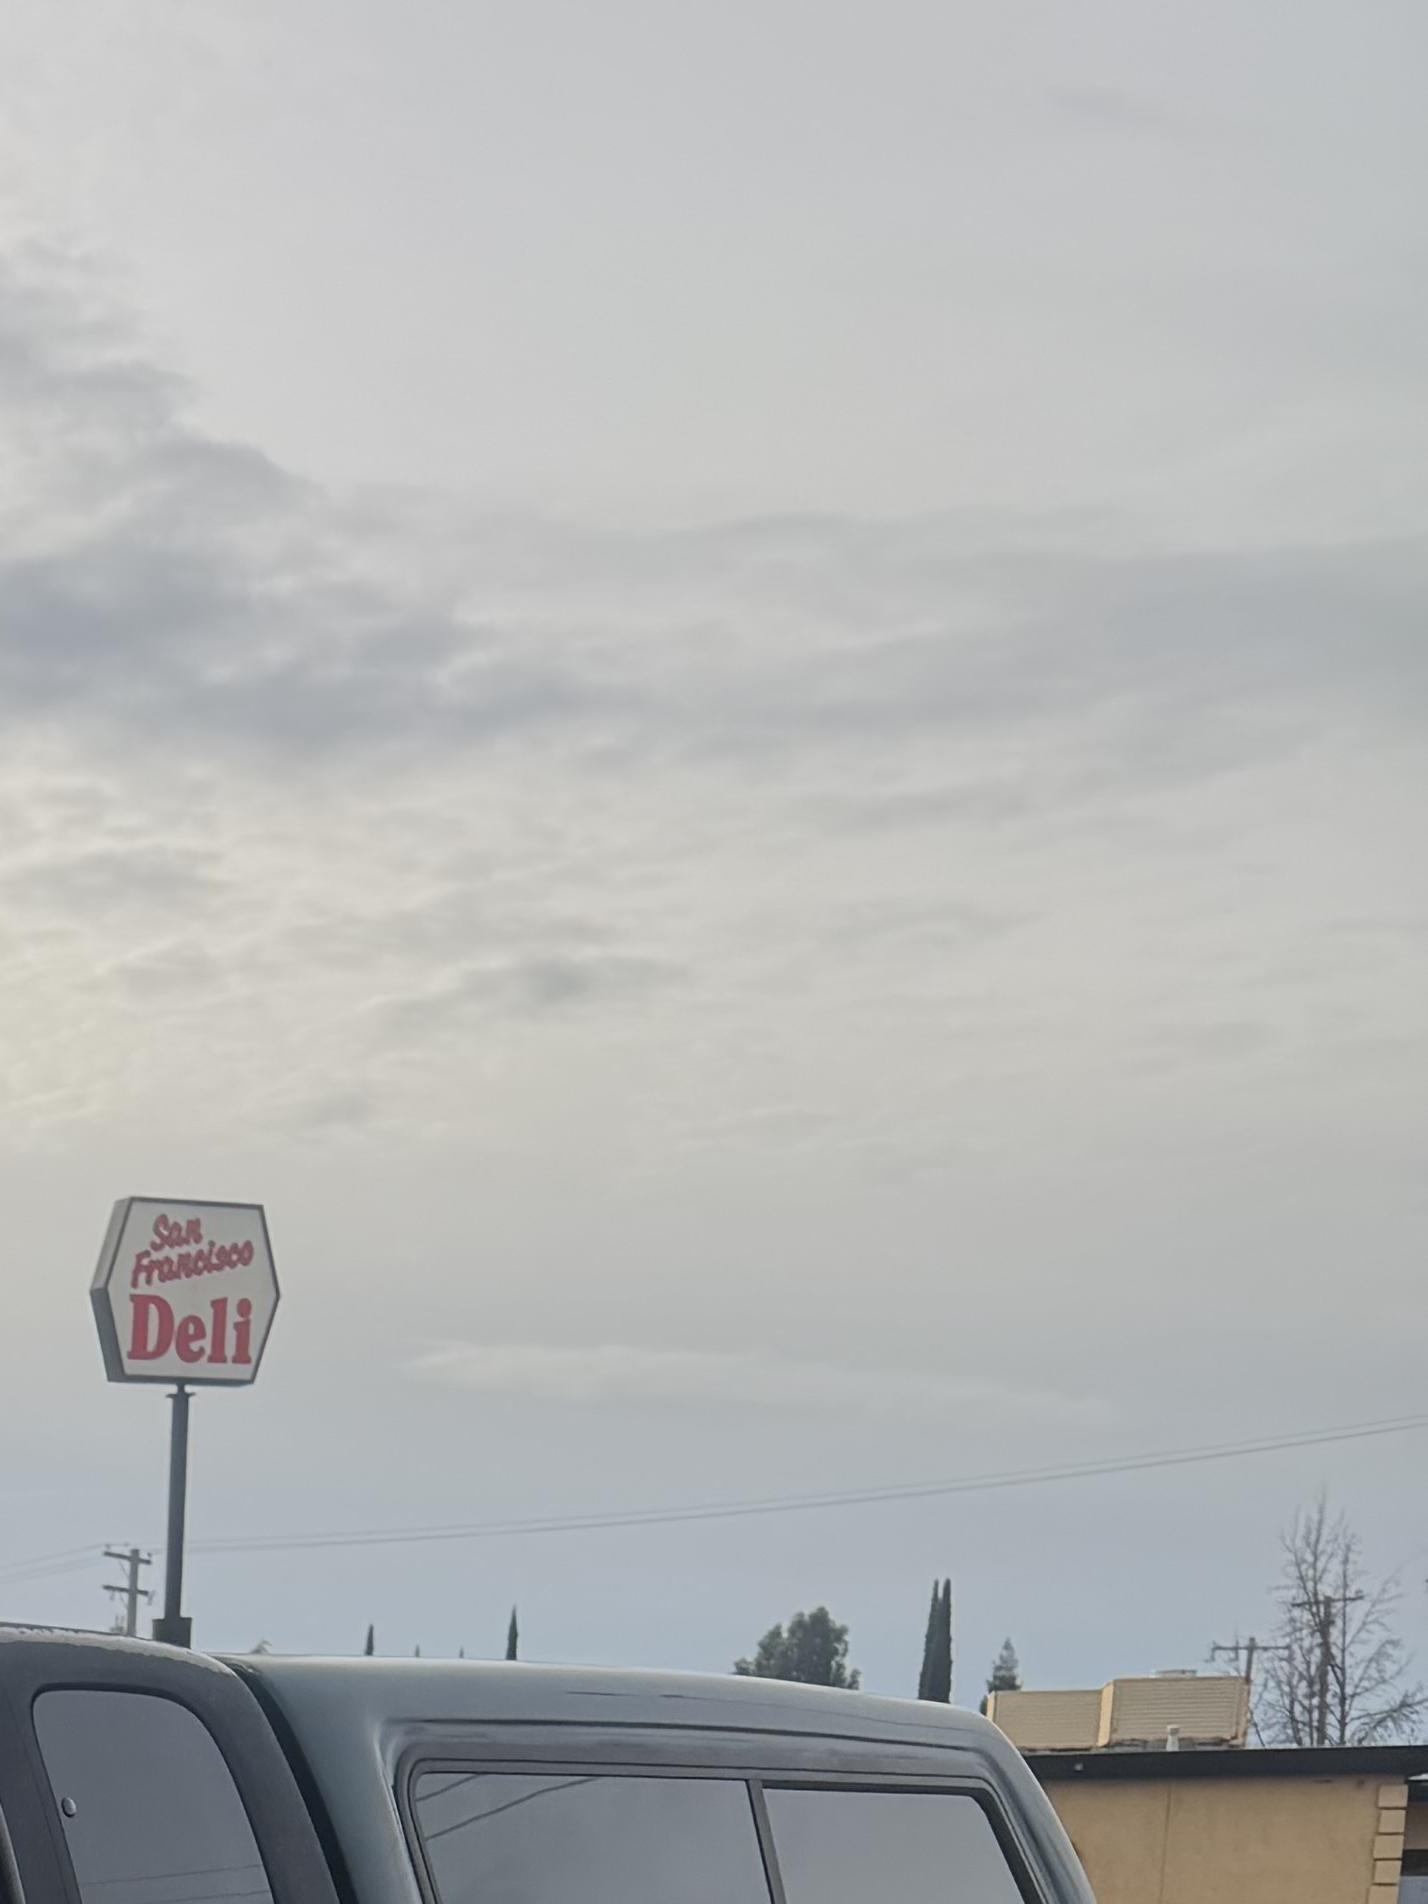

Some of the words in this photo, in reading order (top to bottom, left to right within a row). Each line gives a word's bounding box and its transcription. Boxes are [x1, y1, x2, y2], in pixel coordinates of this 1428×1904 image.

[150, 1213, 203, 1252] San
[130, 1239, 254, 1288] Francisco
[127, 1293, 252, 1364] Deli
